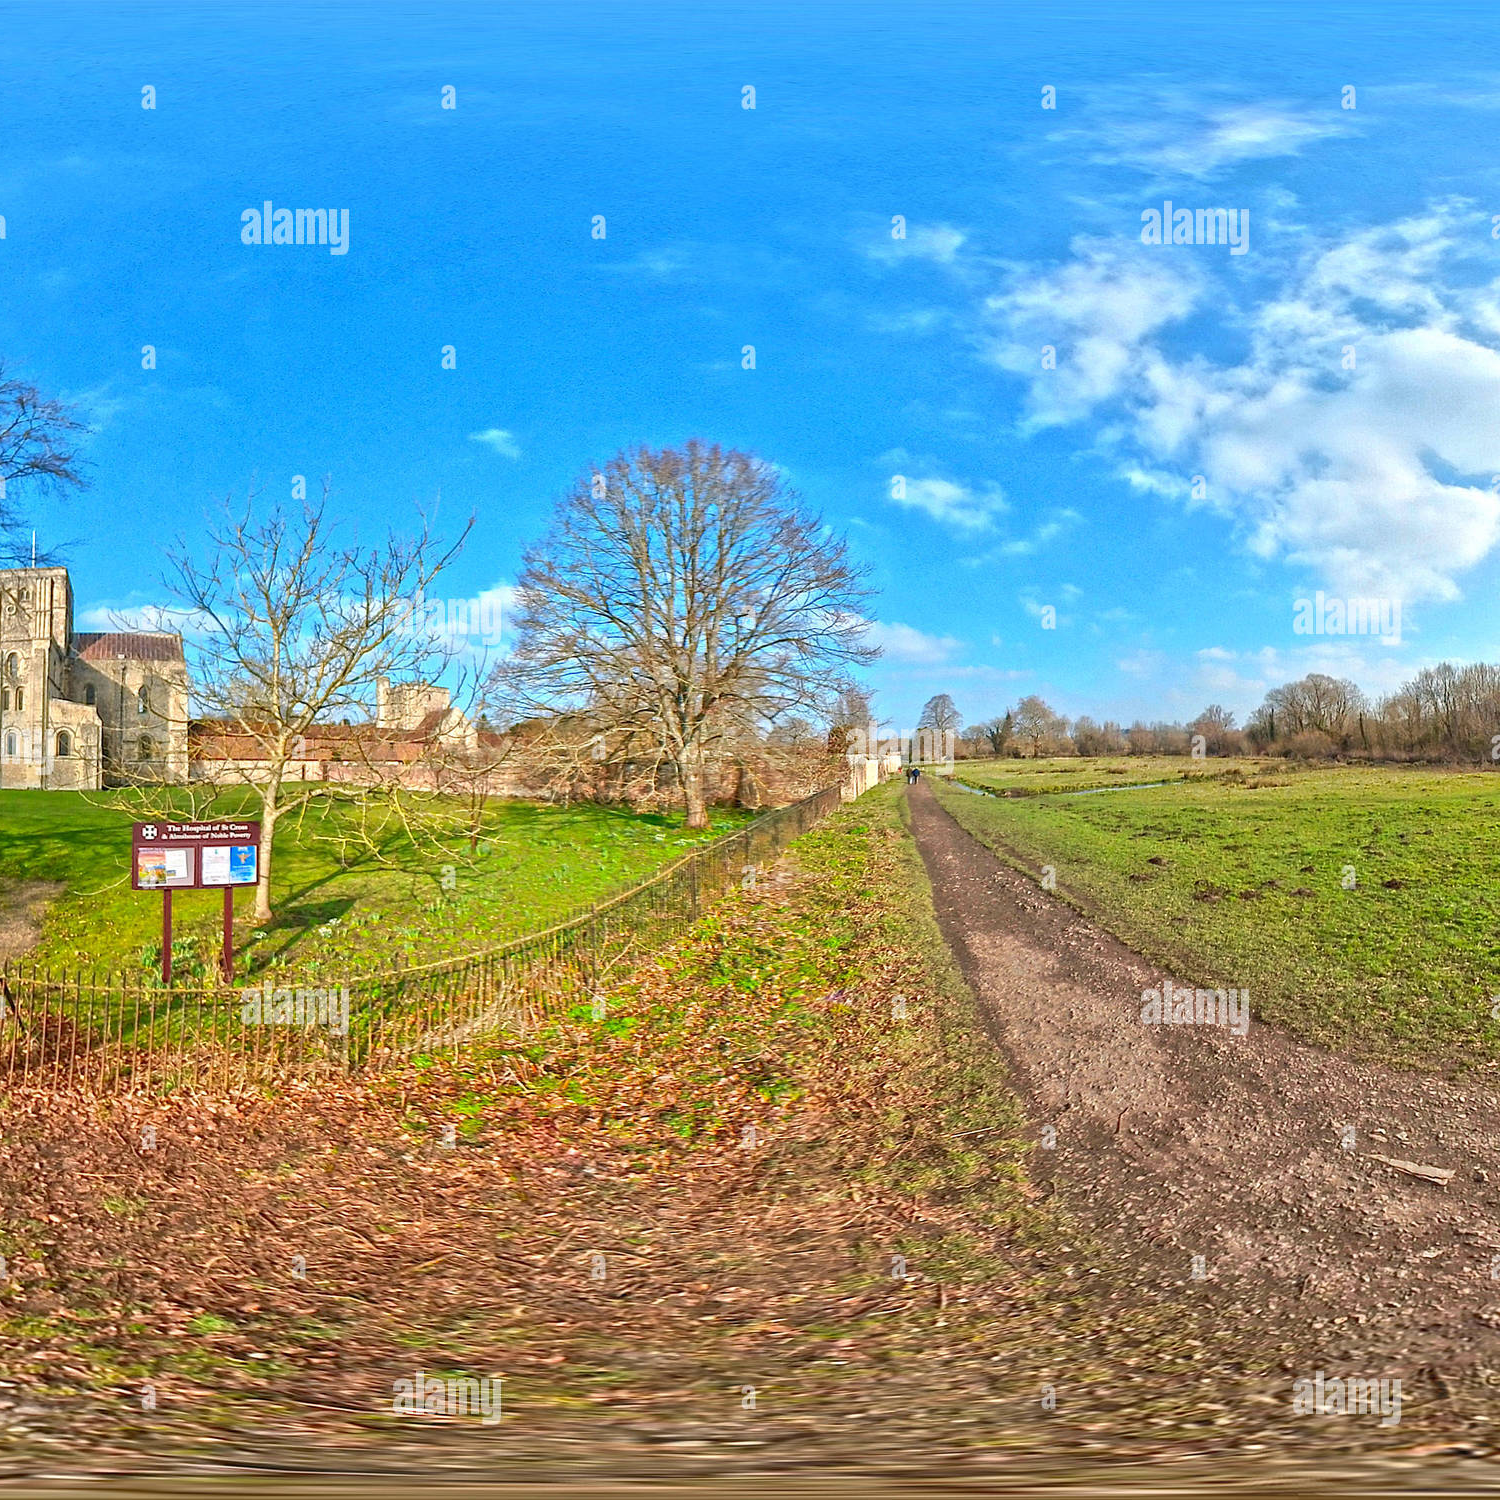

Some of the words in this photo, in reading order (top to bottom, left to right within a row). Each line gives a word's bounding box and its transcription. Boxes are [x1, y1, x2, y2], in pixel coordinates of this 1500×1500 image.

[167, 824, 181, 832] The
[182, 824, 211, 833] Hospital
[229, 823, 248, 831] Cross
[229, 831, 251, 840] Poverty
